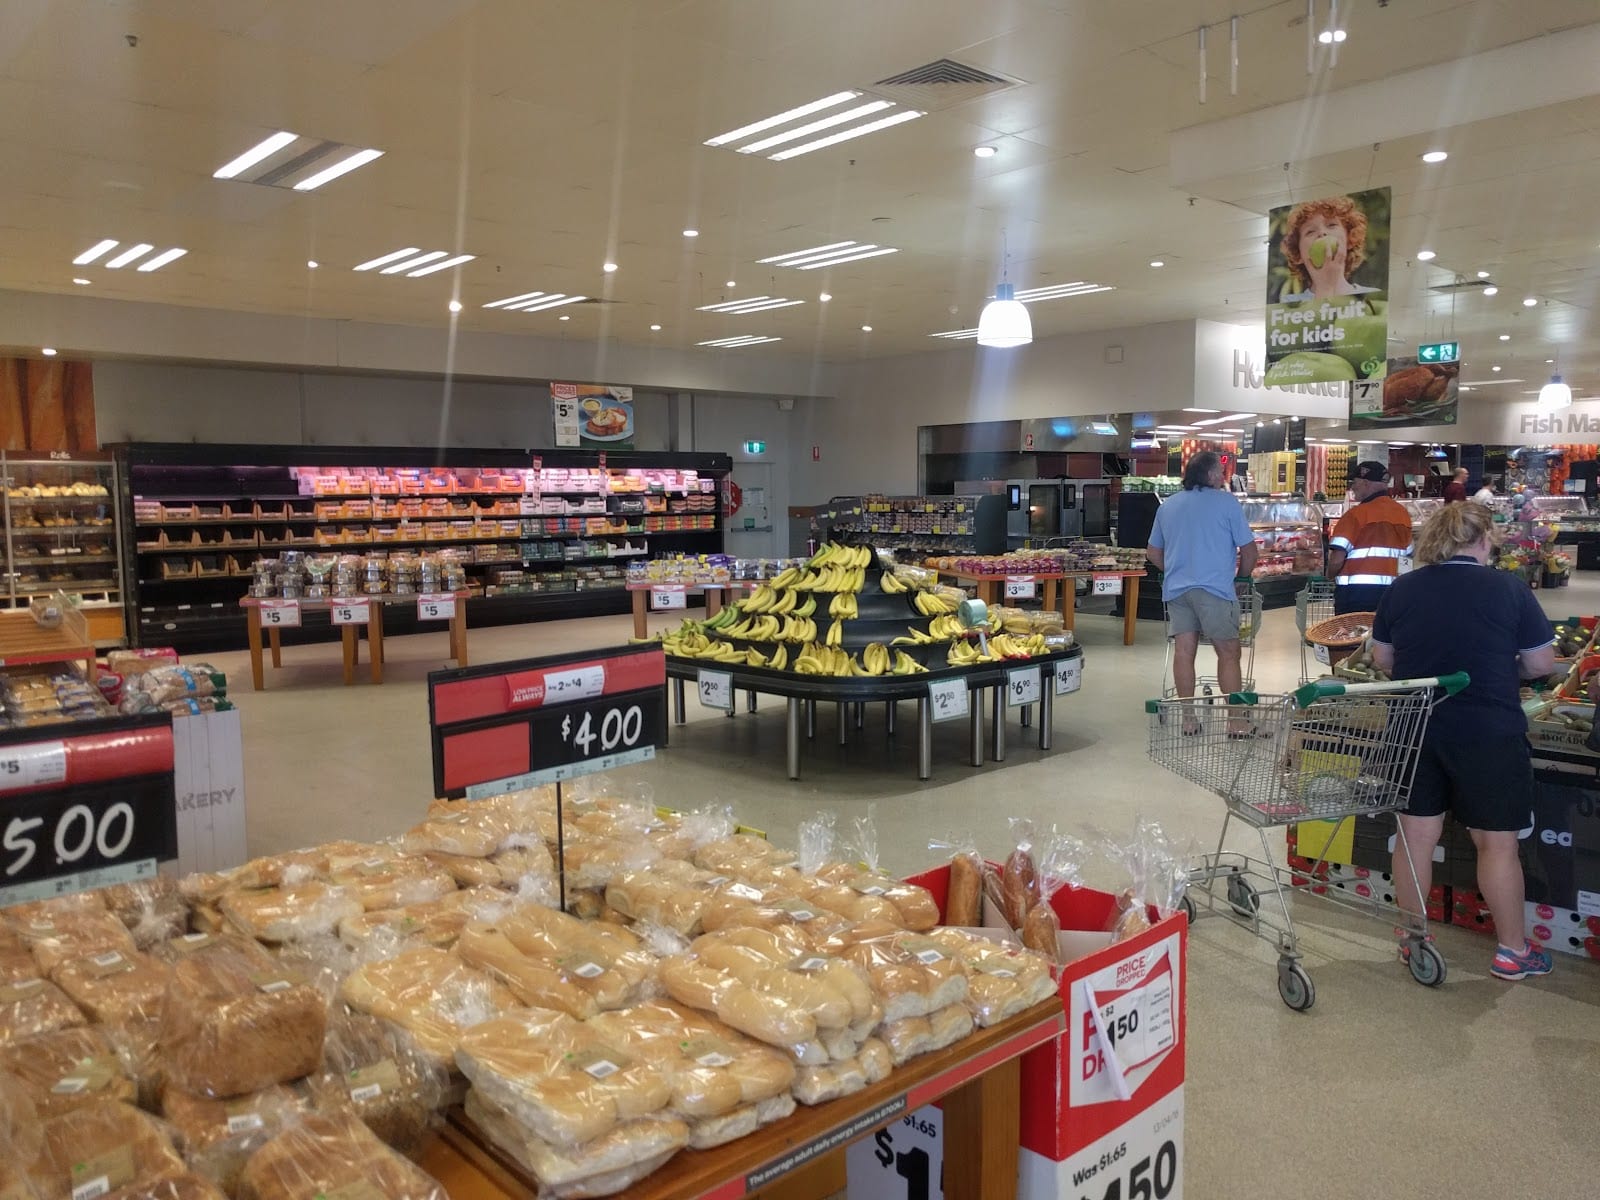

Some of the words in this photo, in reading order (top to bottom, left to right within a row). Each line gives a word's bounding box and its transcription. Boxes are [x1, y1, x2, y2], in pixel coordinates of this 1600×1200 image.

[1270, 308, 1315, 327] Free
[1319, 300, 1367, 321] fruit
[1270, 328, 1299, 347] for
[1302, 324, 1346, 344] kids
[1233, 348, 1271, 390] Ho
[1520, 413, 1563, 434] Fish
[1567, 413, 1600, 433] Ma
[266, 611, 280, 623] $5
[338, 609, 352, 620] $5
[425, 605, 438, 616] $5
[558, 681, 565, 691] 2
[572, 677, 582, 687] $4
[512, 691, 545, 703] ALWAYS
[1116, 955, 1146, 979] PRICE
[1116, 969, 1146, 988] DROPPED
[748, 1172, 764, 1186] The
[764, 1158, 795, 1179] average
[794, 1146, 813, 1163] adult
[813, 1138, 831, 1153] daily
[830, 1126, 854, 1145] energy
[854, 1115, 875, 1130] intake
[874, 1112, 882, 1121] is
[1073, 1165, 1098, 1188] Was
[1099, 1141, 1127, 1172] $1.65
